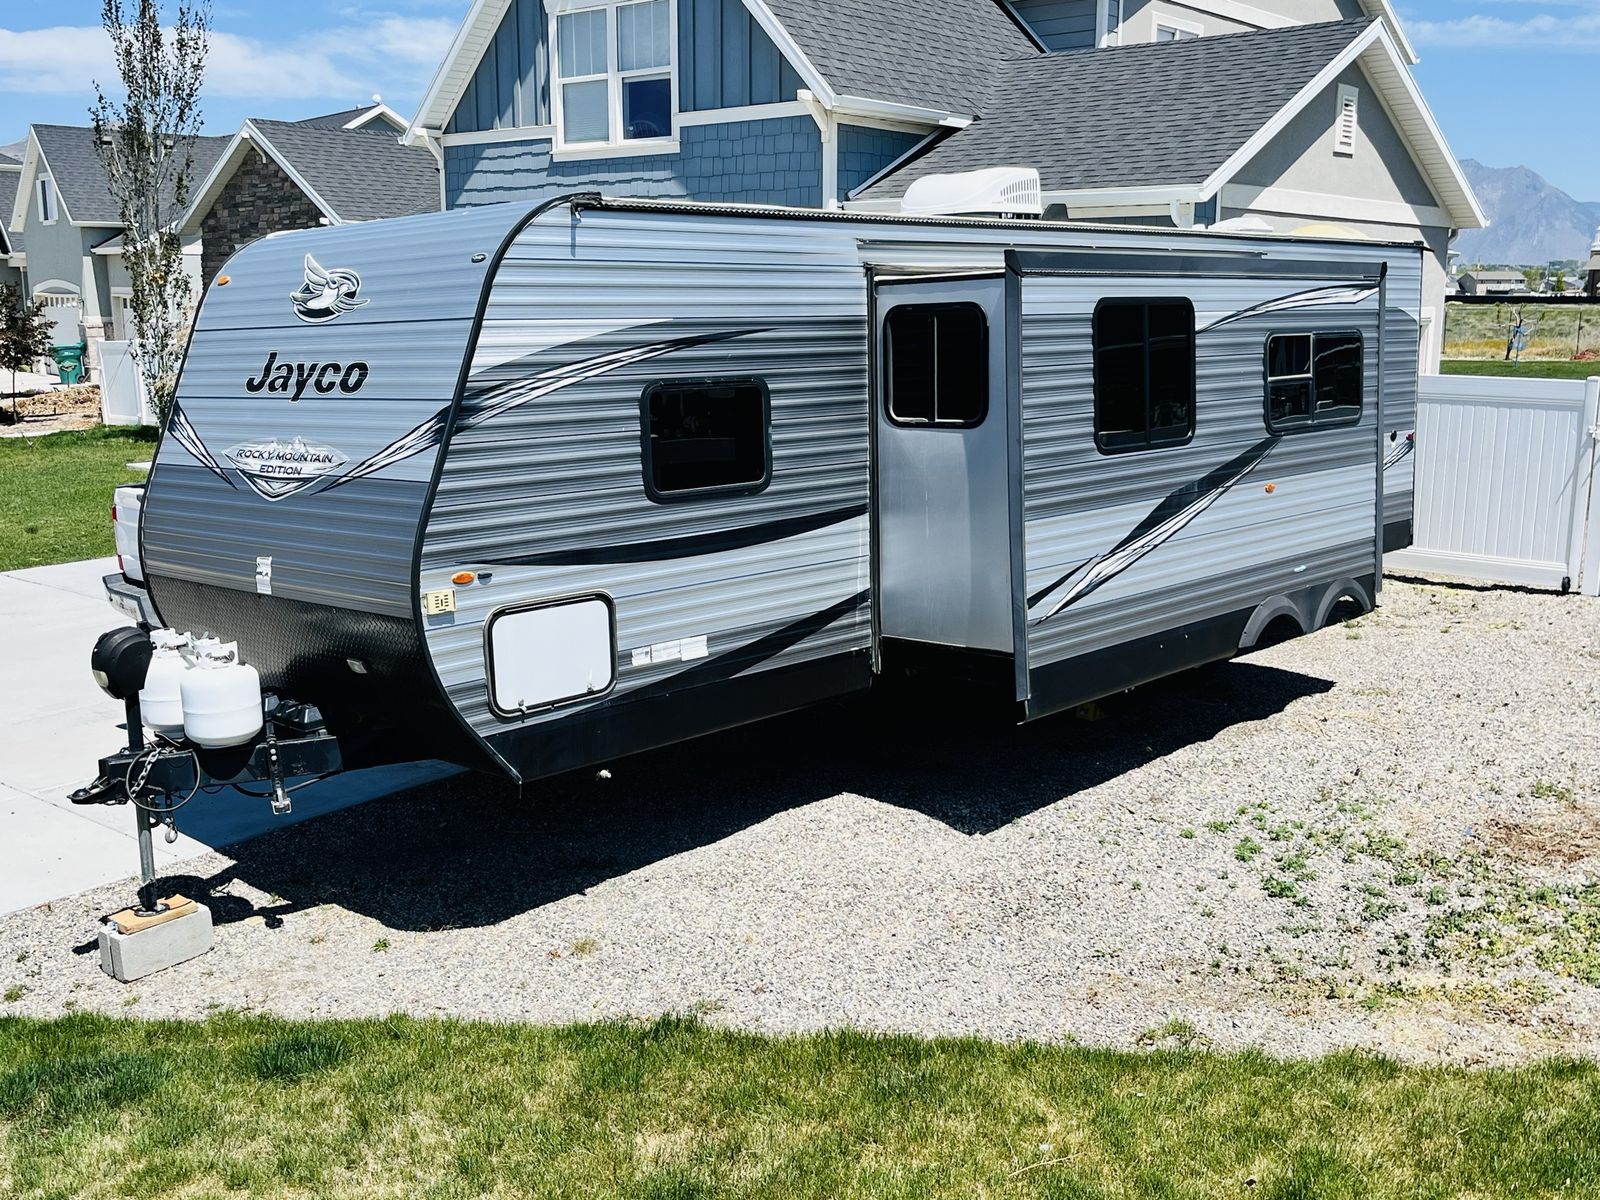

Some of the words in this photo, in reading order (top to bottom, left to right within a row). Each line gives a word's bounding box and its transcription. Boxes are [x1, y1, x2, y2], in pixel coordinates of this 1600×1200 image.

[246, 351, 369, 402] Jayco
[236, 449, 275, 461] ROCKY
[276, 451, 334, 463] MOUNTAIN
[260, 464, 302, 475] EDITION
